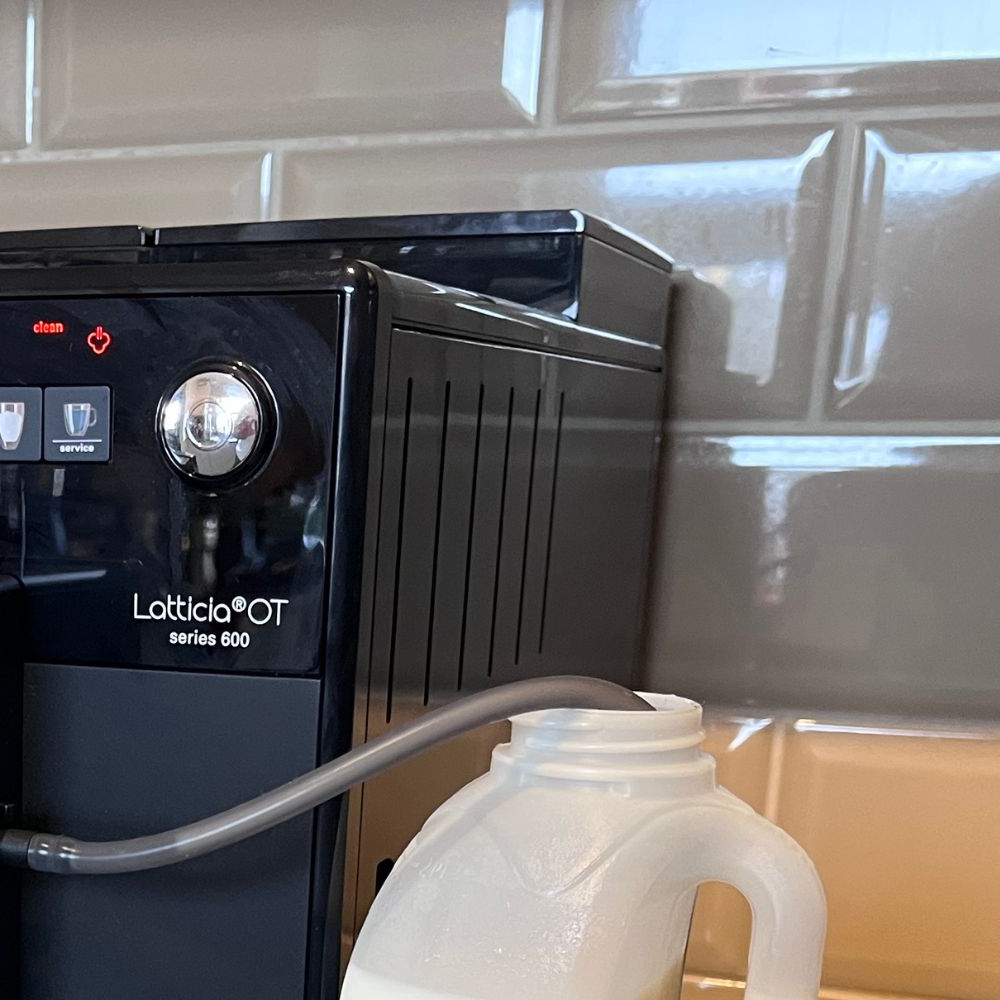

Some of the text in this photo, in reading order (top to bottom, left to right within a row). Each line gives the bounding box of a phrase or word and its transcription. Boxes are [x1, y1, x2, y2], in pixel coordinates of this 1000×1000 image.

[32, 320, 64, 334] clean
[59, 442, 95, 453] service
[169, 629, 250, 648] series 600
